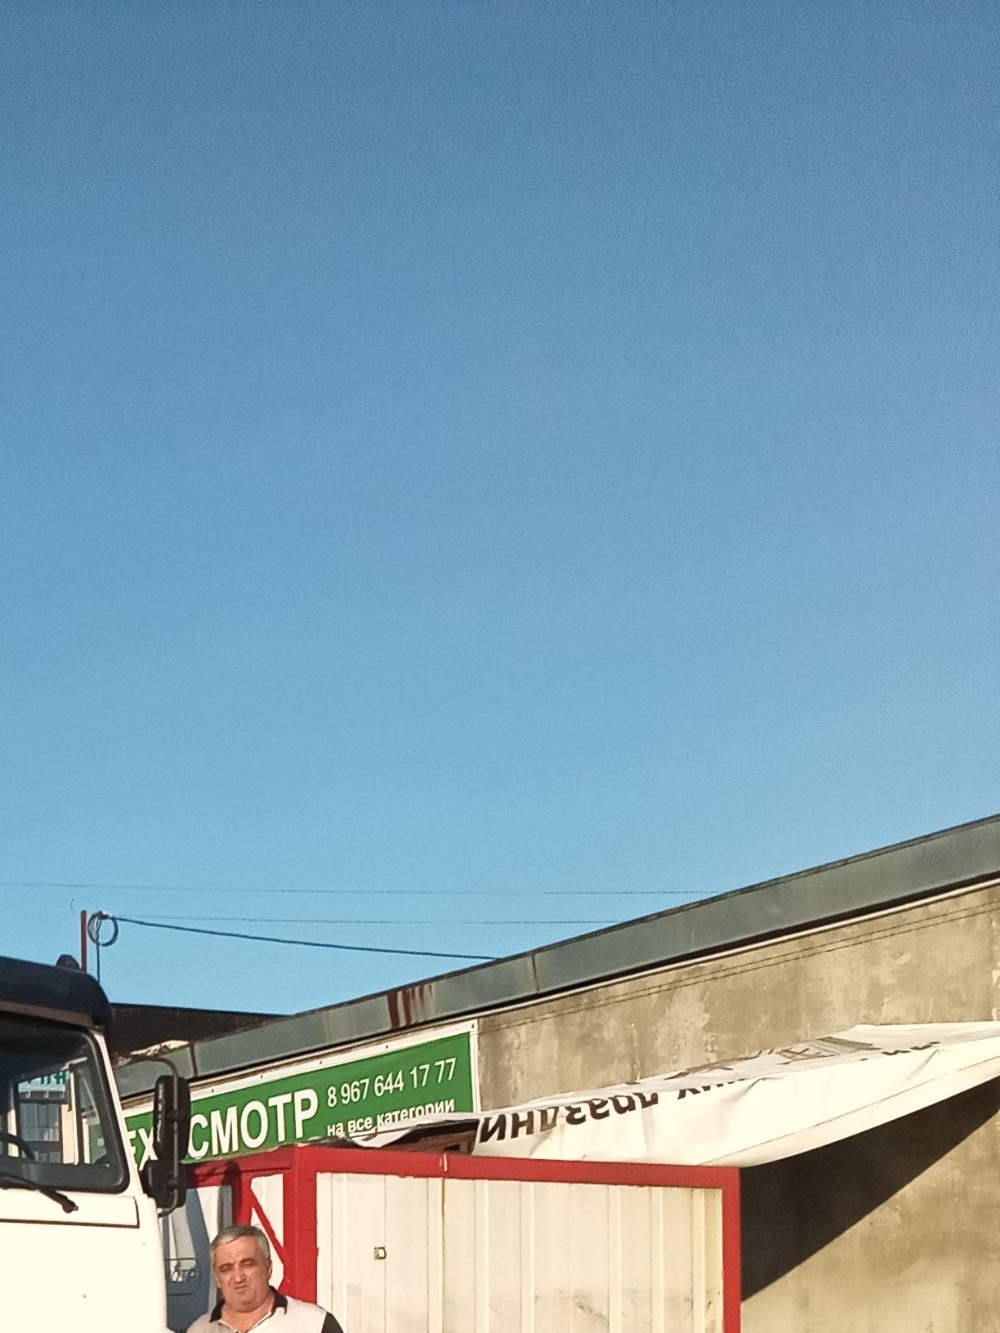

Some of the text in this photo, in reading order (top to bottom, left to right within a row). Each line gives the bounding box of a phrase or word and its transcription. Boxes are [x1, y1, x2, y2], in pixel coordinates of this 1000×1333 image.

[327, 1057, 456, 1107] 8 967 644 17 77
[327, 1099, 455, 1138] на все категории
